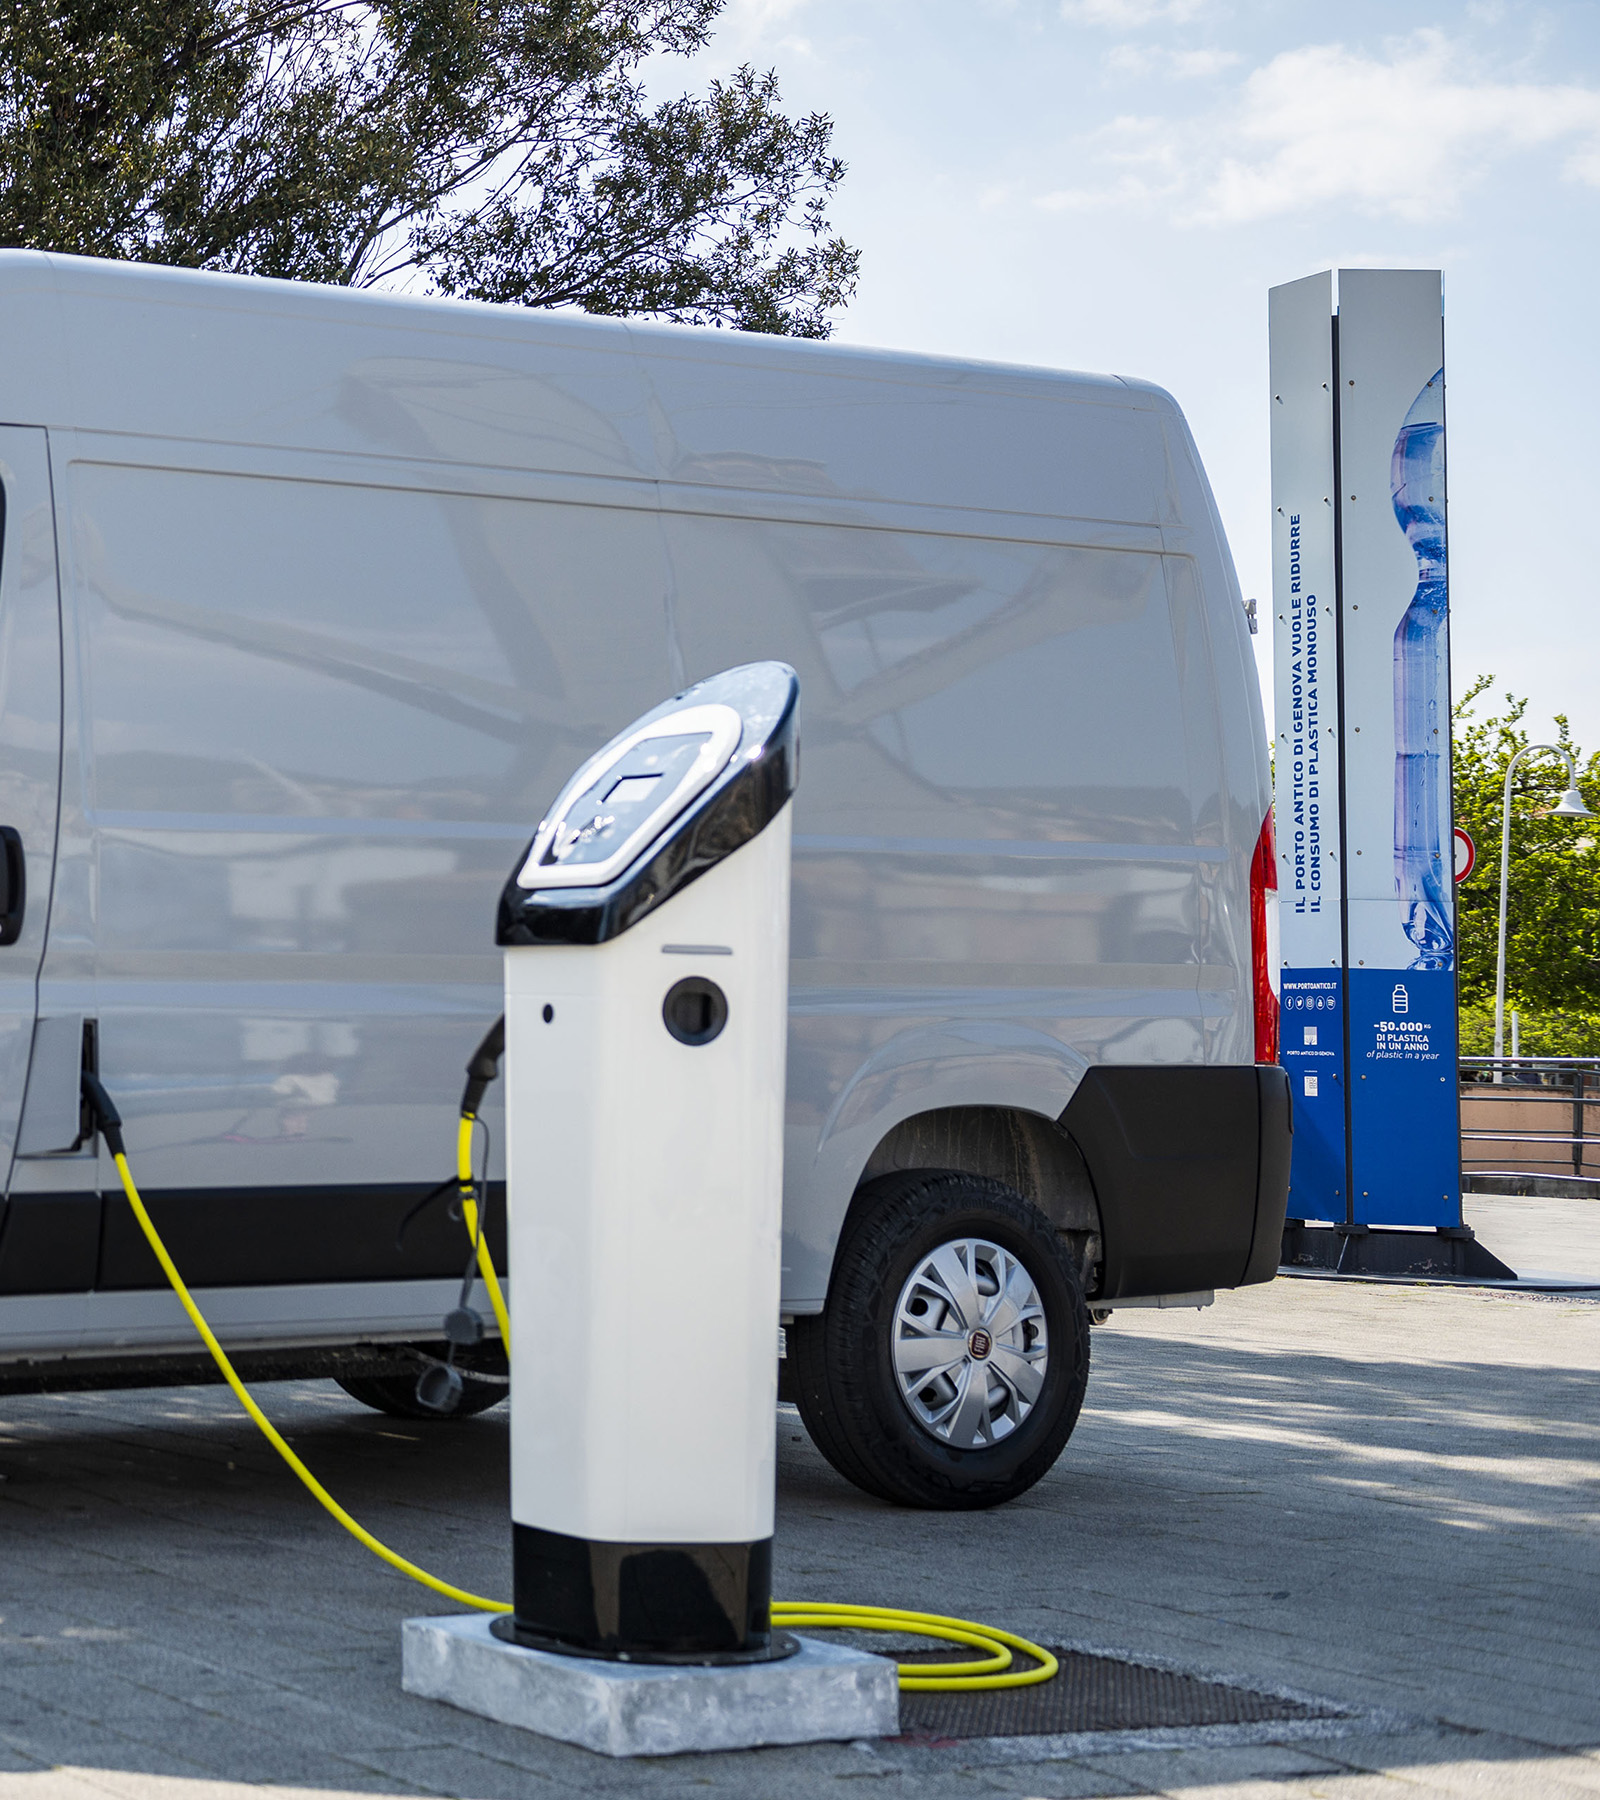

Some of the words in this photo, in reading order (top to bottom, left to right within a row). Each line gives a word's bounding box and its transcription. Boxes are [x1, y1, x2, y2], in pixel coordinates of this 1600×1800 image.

[1290, 514, 1301, 593] RIDURRE
[1291, 598, 1302, 657] VUOLE
[1306, 594, 1317, 683] MONOUSO
[1292, 660, 1303, 733] GENOVA
[1307, 687, 1319, 775] PLASTICA
[1293, 738, 1303, 756] DI
[1293, 760, 1304, 825] ANTICO
[1308, 780, 1319, 798] DI
[1309, 803, 1320, 891] CONSUMO
[1294, 830, 1305, 890] PORTO
[1295, 896, 1306, 914] IL
[1310, 895, 1321, 912] IL
[1283, 982, 1337, 990] WWW.PORTOANTICO.IT
[1373, 1021, 1423, 1032] -50.000
[1376, 1033, 1385, 1041] DI
[1387, 1034, 1429, 1042] PLASTICA
[1376, 1042, 1386, 1050] IN
[1388, 1042, 1401, 1050] UN
[1403, 1043, 1429, 1051] ANNO
[1366, 1050, 1375, 1058] of
[1375, 1050, 1403, 1060] plastic
[1404, 1051, 1413, 1059] in
[1421, 1053, 1440, 1061] year
[973, 1333, 987, 1354] FIAT
